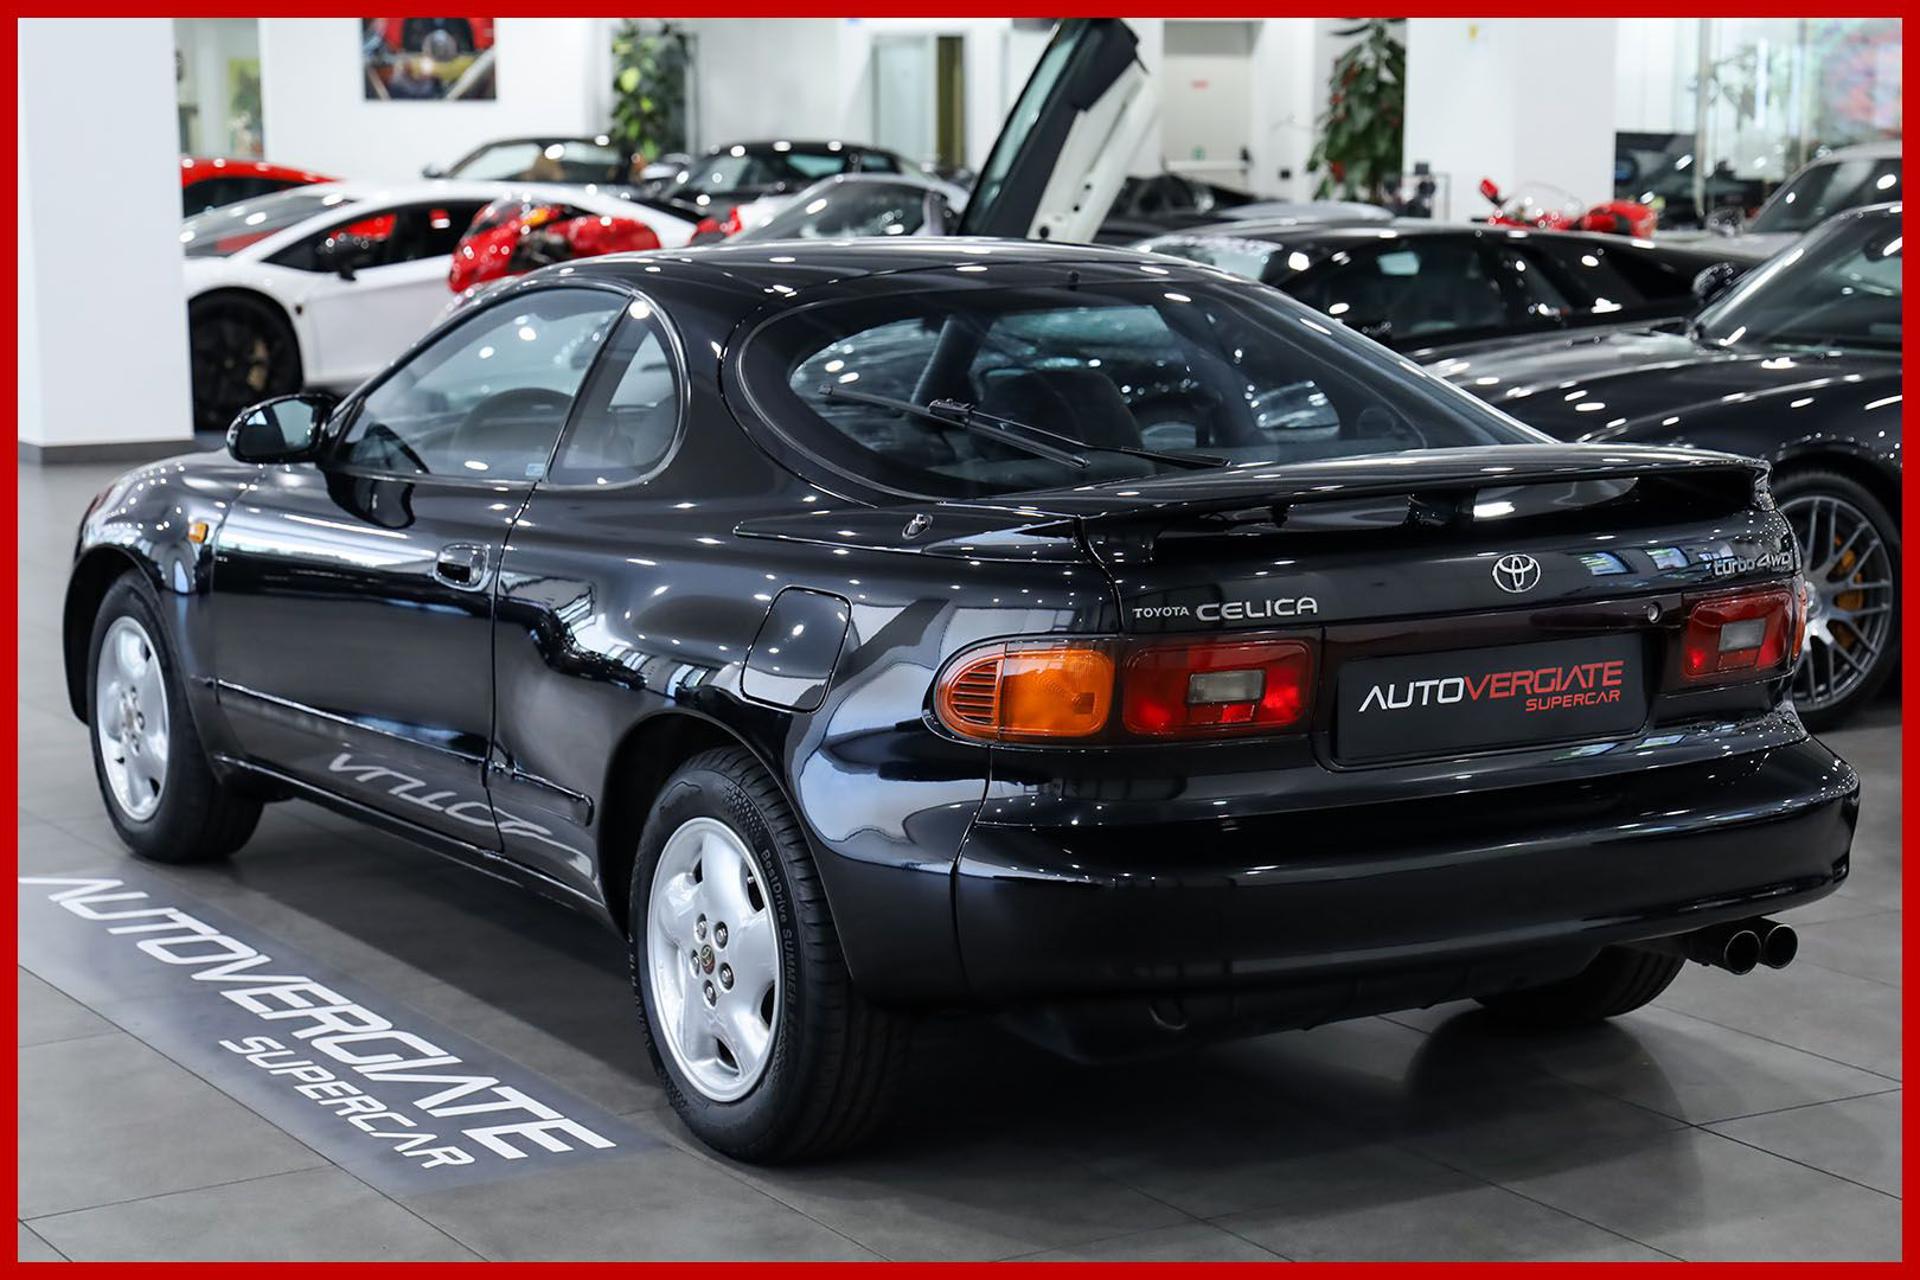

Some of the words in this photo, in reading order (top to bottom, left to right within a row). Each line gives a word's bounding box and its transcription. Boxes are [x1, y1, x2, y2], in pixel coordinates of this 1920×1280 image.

[1133, 606, 1190, 618] TOYOTA
[1196, 597, 1318, 621] CELICA
[1358, 660, 1624, 712] AUTOVERGIATE
[1525, 690, 1621, 712] SUPERCAR
[761, 849, 788, 923] BestDrive
[782, 928, 797, 1005] SUMMER
[18, 878, 616, 1159] AUTOVERGIATE
[219, 1036, 475, 1168] SUPERCAR
